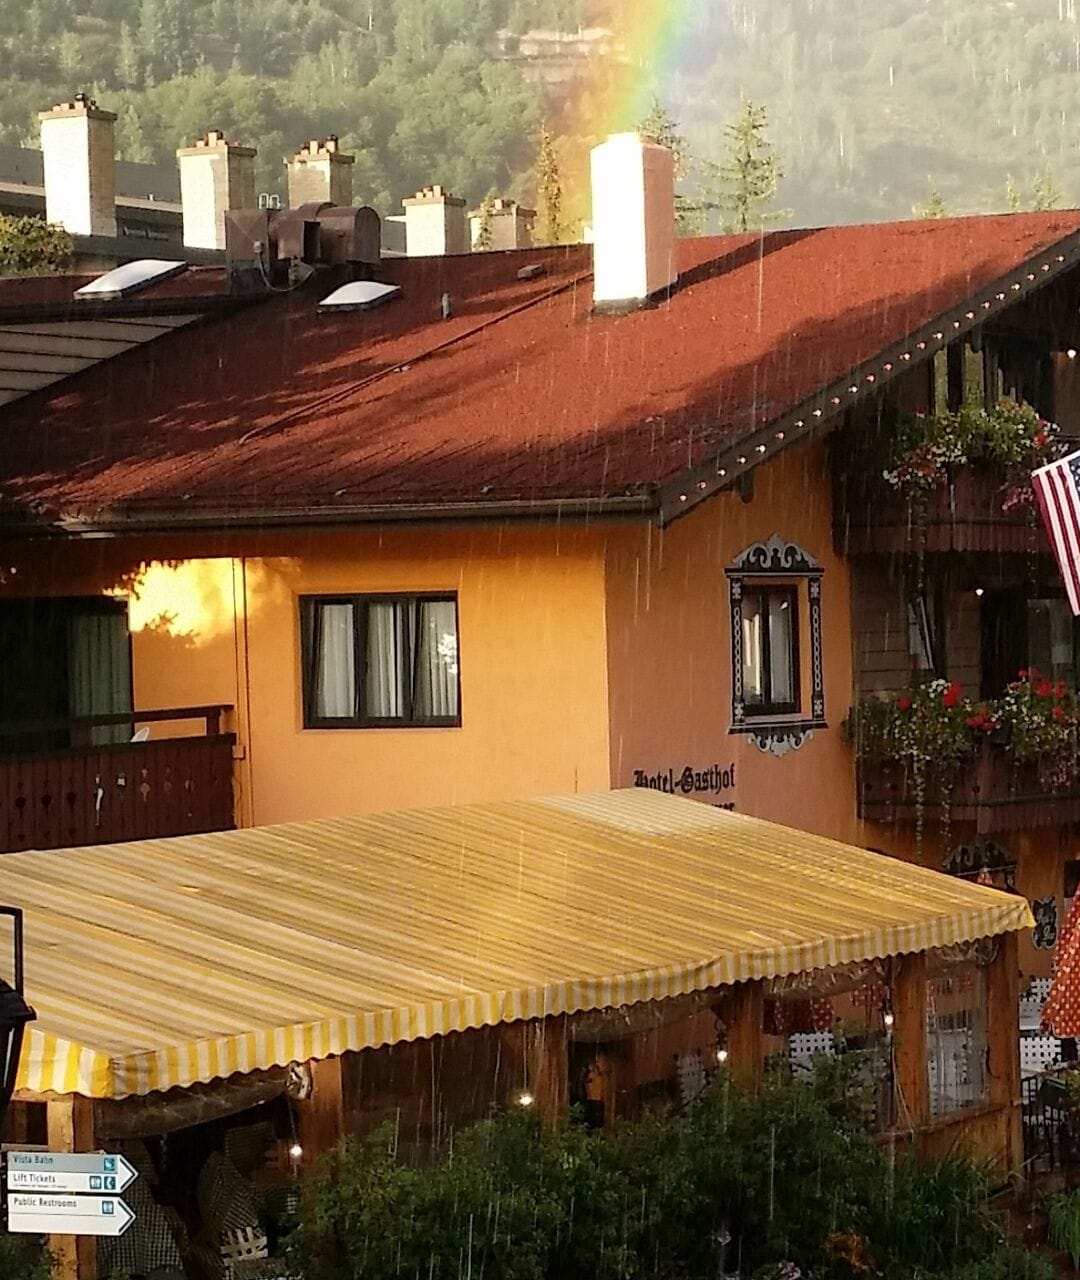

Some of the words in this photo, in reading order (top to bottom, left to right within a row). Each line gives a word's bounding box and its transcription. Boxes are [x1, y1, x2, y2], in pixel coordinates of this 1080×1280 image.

[13, 1155, 32, 1164] Vista
[13, 1173, 27, 1182] Lift
[29, 1173, 56, 1183] Tickets
[13, 1197, 37, 1206] Public
[39, 1198, 77, 1208] Restrooms
